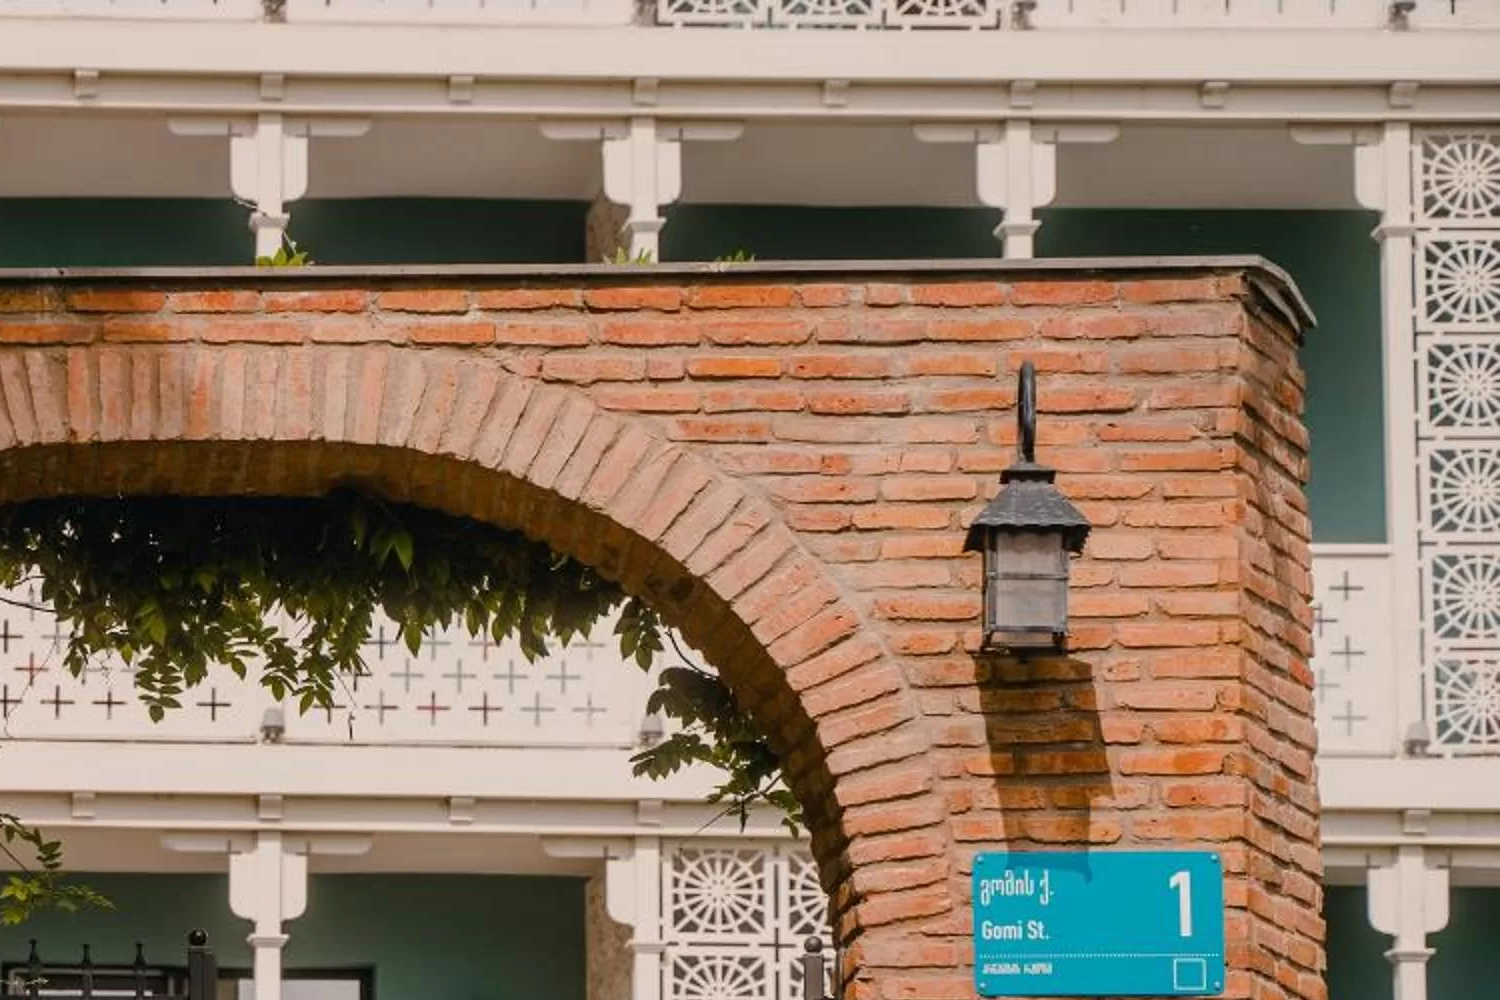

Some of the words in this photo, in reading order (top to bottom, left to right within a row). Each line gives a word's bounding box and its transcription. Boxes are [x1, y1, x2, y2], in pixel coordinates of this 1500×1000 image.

[980, 869, 1035, 906] გომის
[1169, 870, 1192, 937] 1
[981, 920, 1023, 940] Gomi
[1027, 920, 1050, 940] St.
